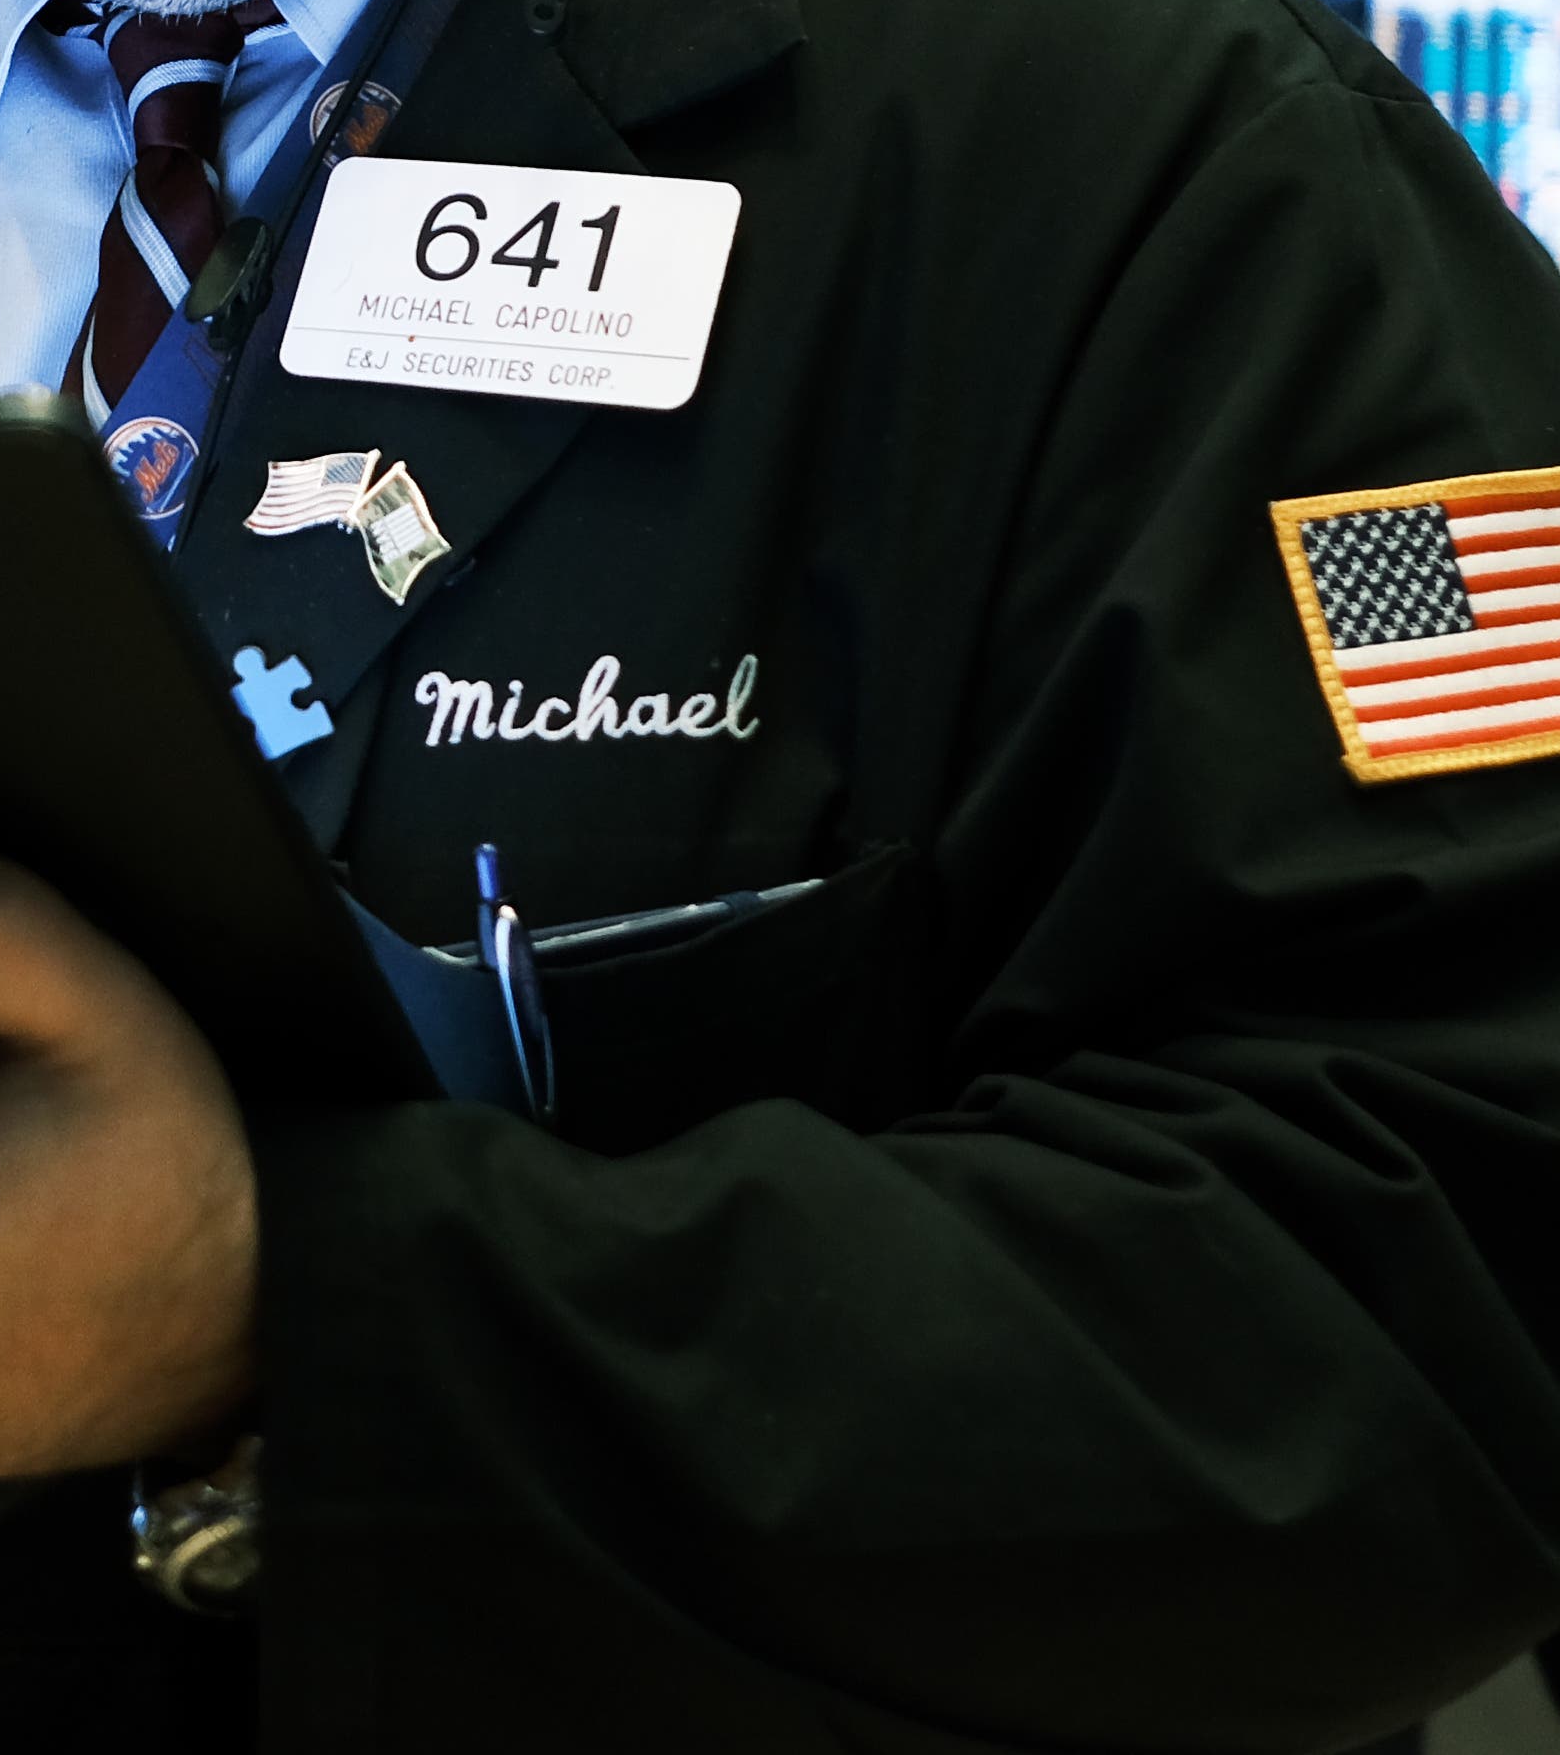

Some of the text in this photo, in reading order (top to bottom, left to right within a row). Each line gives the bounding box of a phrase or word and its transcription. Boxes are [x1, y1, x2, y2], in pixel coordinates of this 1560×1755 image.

[415, 193, 621, 293] 641
[358, 294, 633, 338] MICHAEL CAPOLINO
[346, 347, 389, 371] E&J
[402, 352, 534, 382] SECURITIES
[414, 654, 759, 747] Michael
